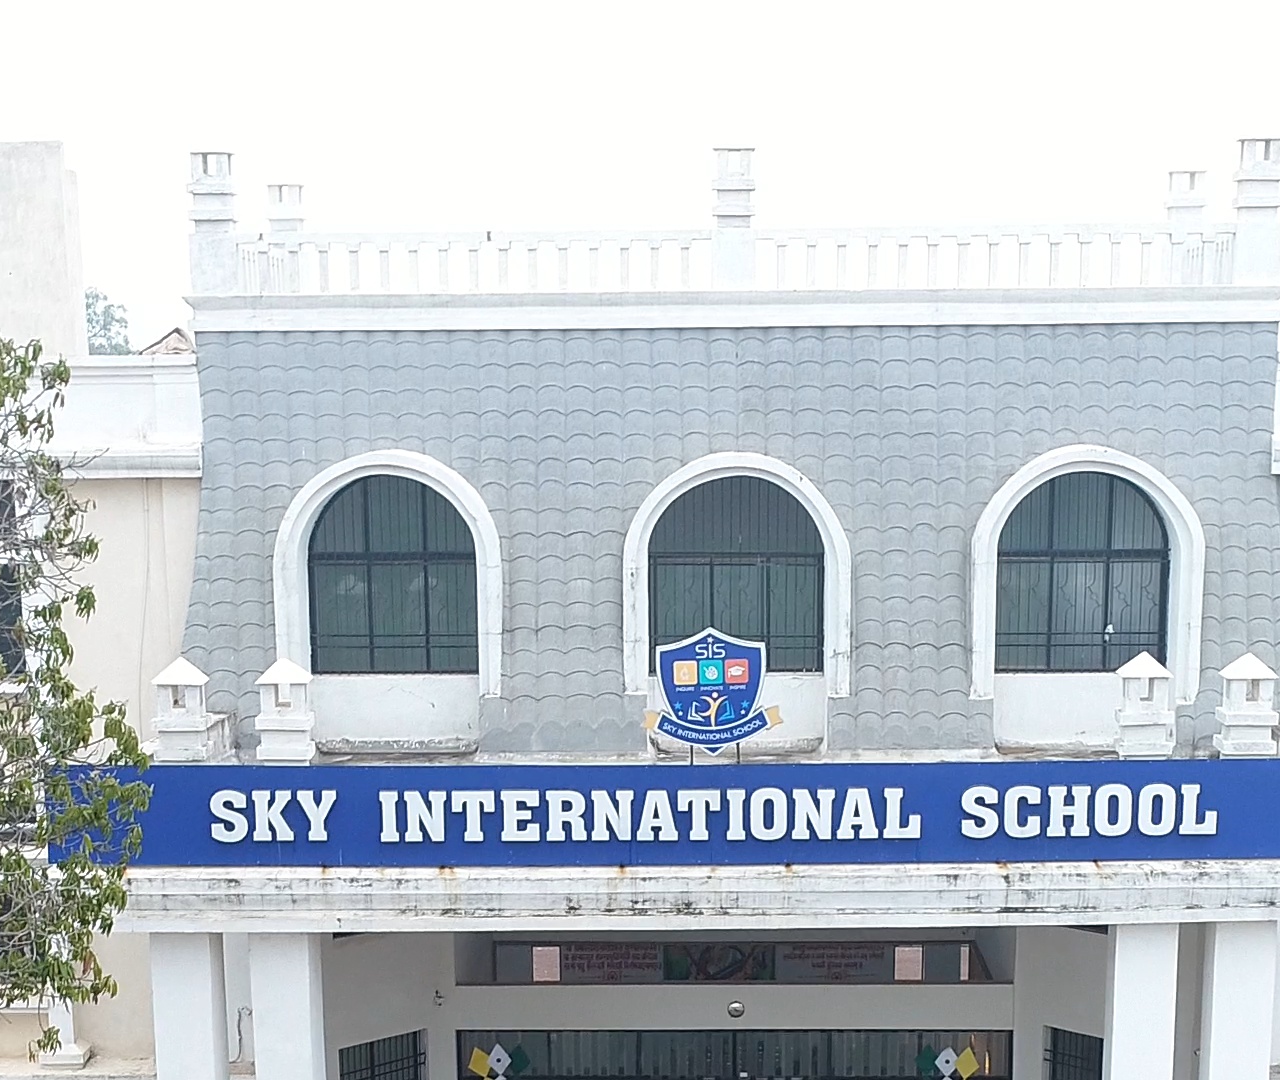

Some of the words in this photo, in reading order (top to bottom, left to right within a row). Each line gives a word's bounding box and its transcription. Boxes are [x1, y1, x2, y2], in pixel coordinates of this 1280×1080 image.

[695, 643, 726, 659] SIS
[662, 722, 677, 734] SKY
[677, 728, 732, 740] INTERNATIONAL
[732, 719, 763, 736] SCHOOL
[209, 788, 338, 843] SKY
[378, 787, 923, 843] INTERNATIONAL
[960, 783, 1219, 839] SCHOOL
